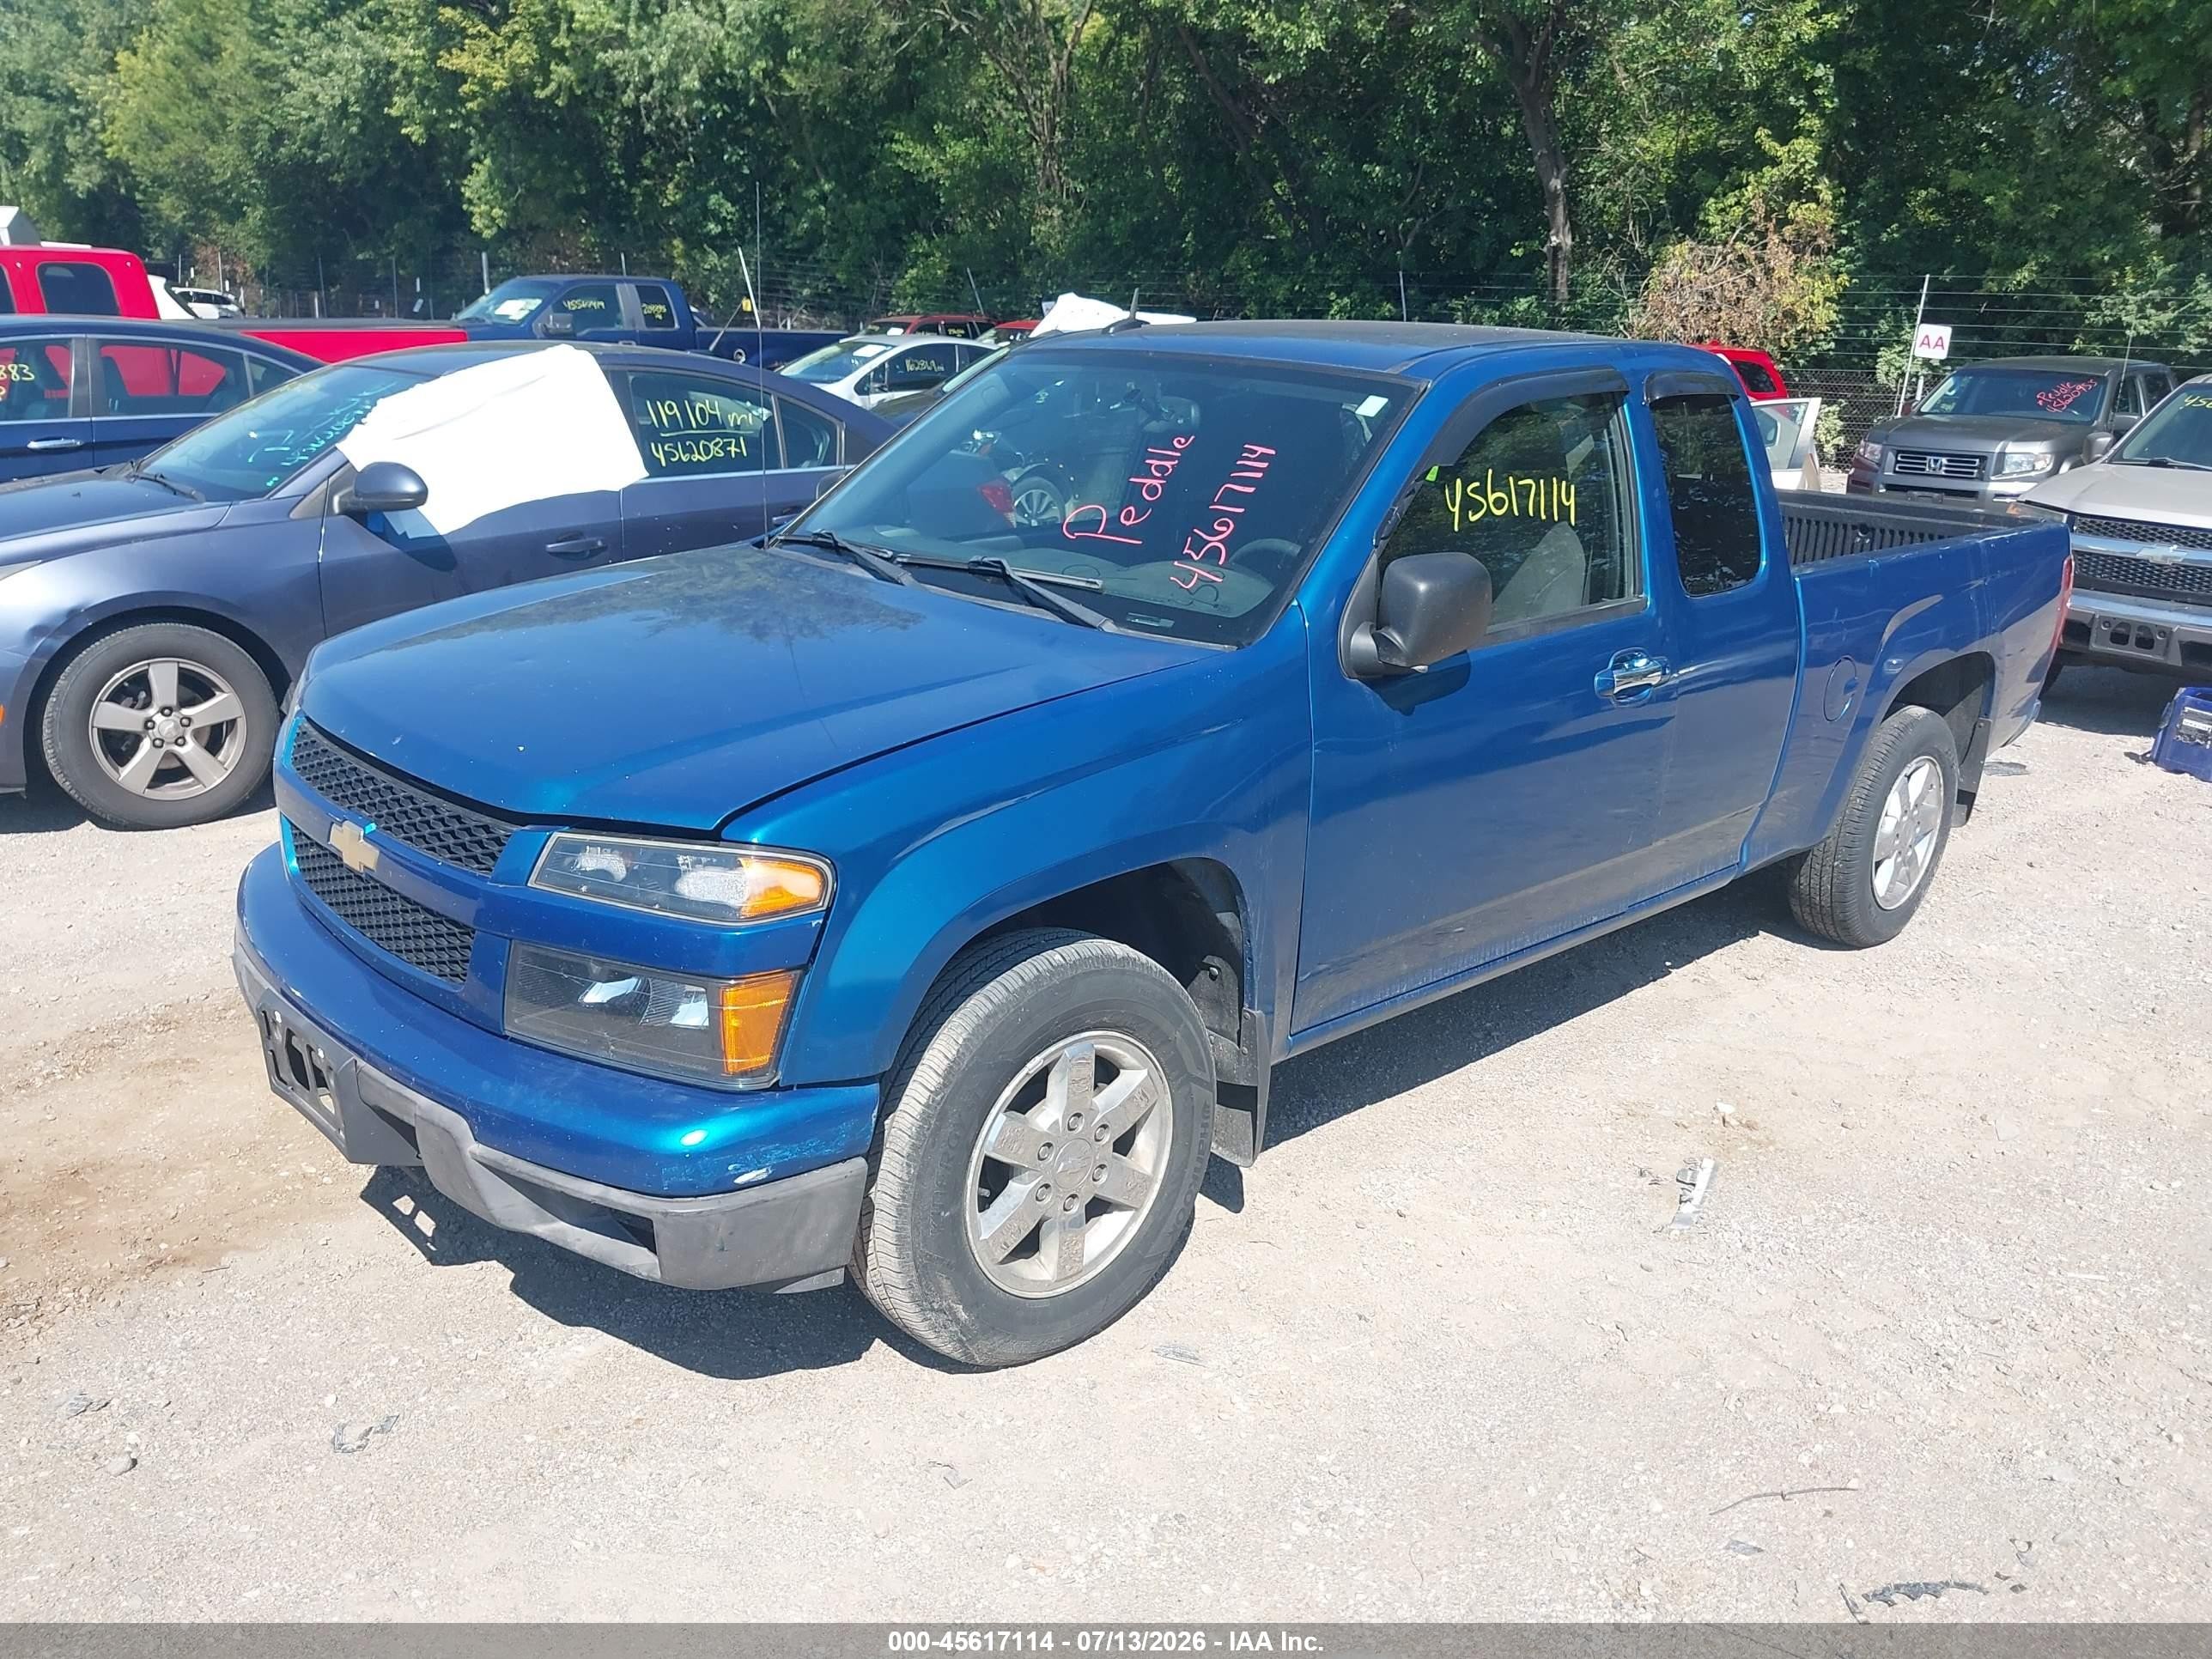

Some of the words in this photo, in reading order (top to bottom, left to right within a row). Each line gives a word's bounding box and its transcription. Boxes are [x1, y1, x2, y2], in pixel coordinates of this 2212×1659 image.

[1918, 334, 1945, 350] AA
[646, 398, 722, 429] 119104
[728, 411, 753, 427] mi
[650, 435, 747, 468] 45620871
[1062, 434, 1195, 545] Peddle
[1444, 467, 1577, 533] 45617114
[1170, 443, 1276, 590] 45617114
